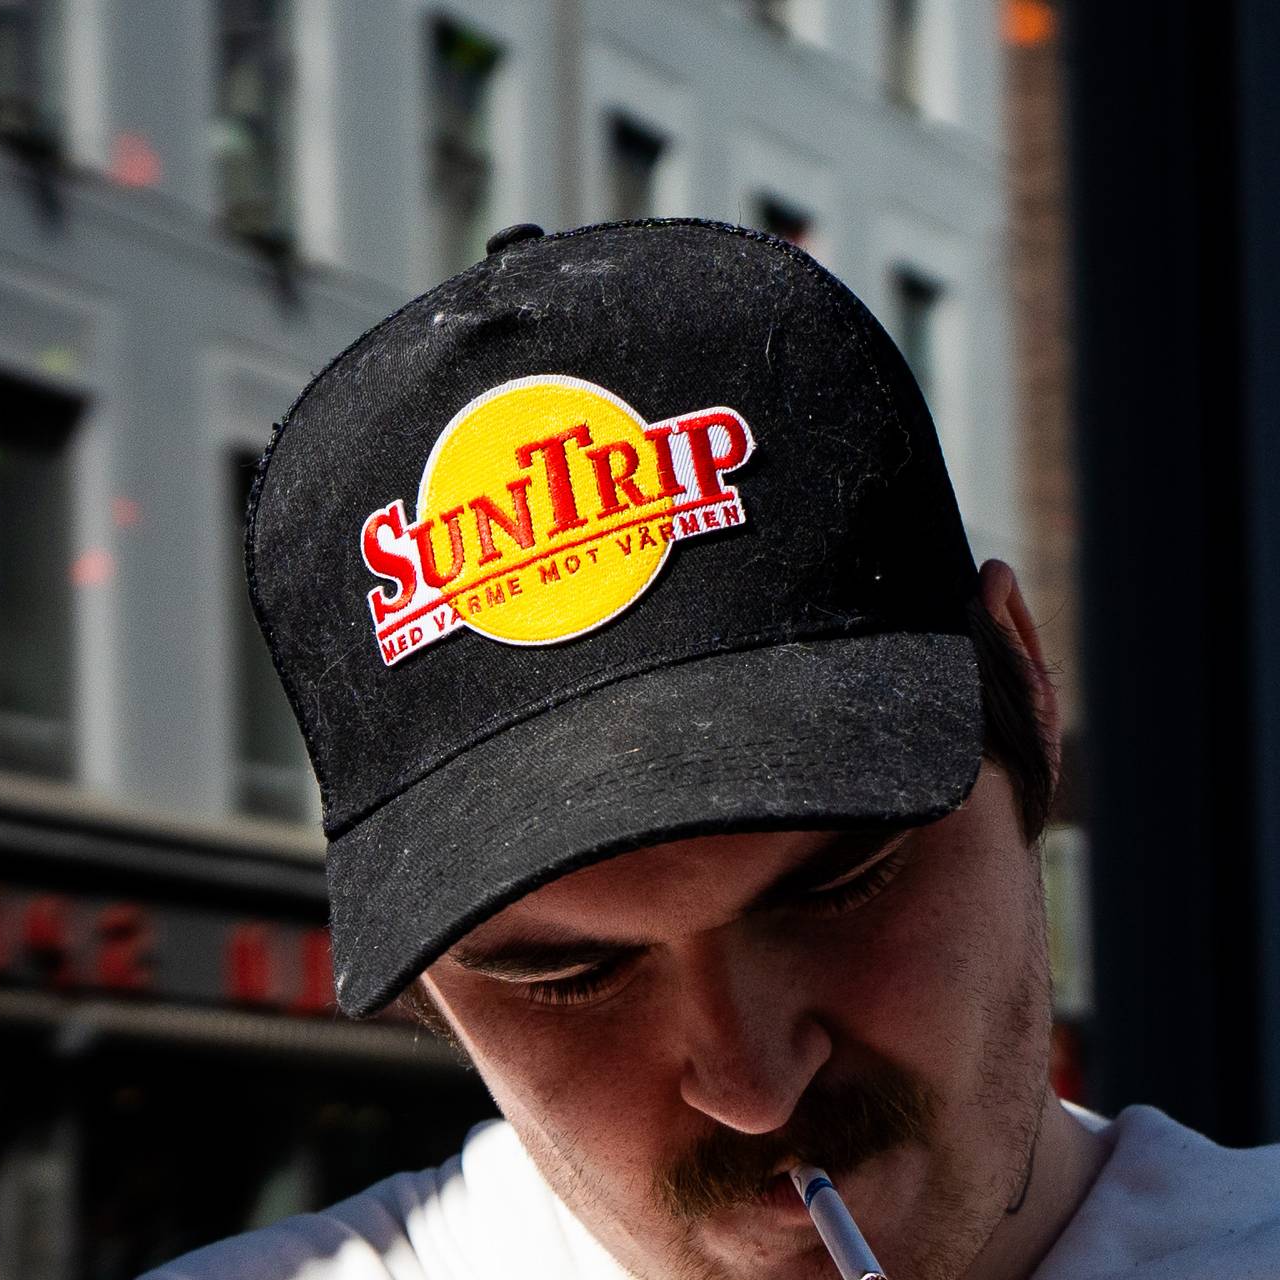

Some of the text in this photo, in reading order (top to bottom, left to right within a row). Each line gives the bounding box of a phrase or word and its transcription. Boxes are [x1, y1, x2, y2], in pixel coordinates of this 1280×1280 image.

[381, 627, 423, 663] MED
[433, 577, 522, 632] VÄRME
[538, 548, 599, 584] MOT
